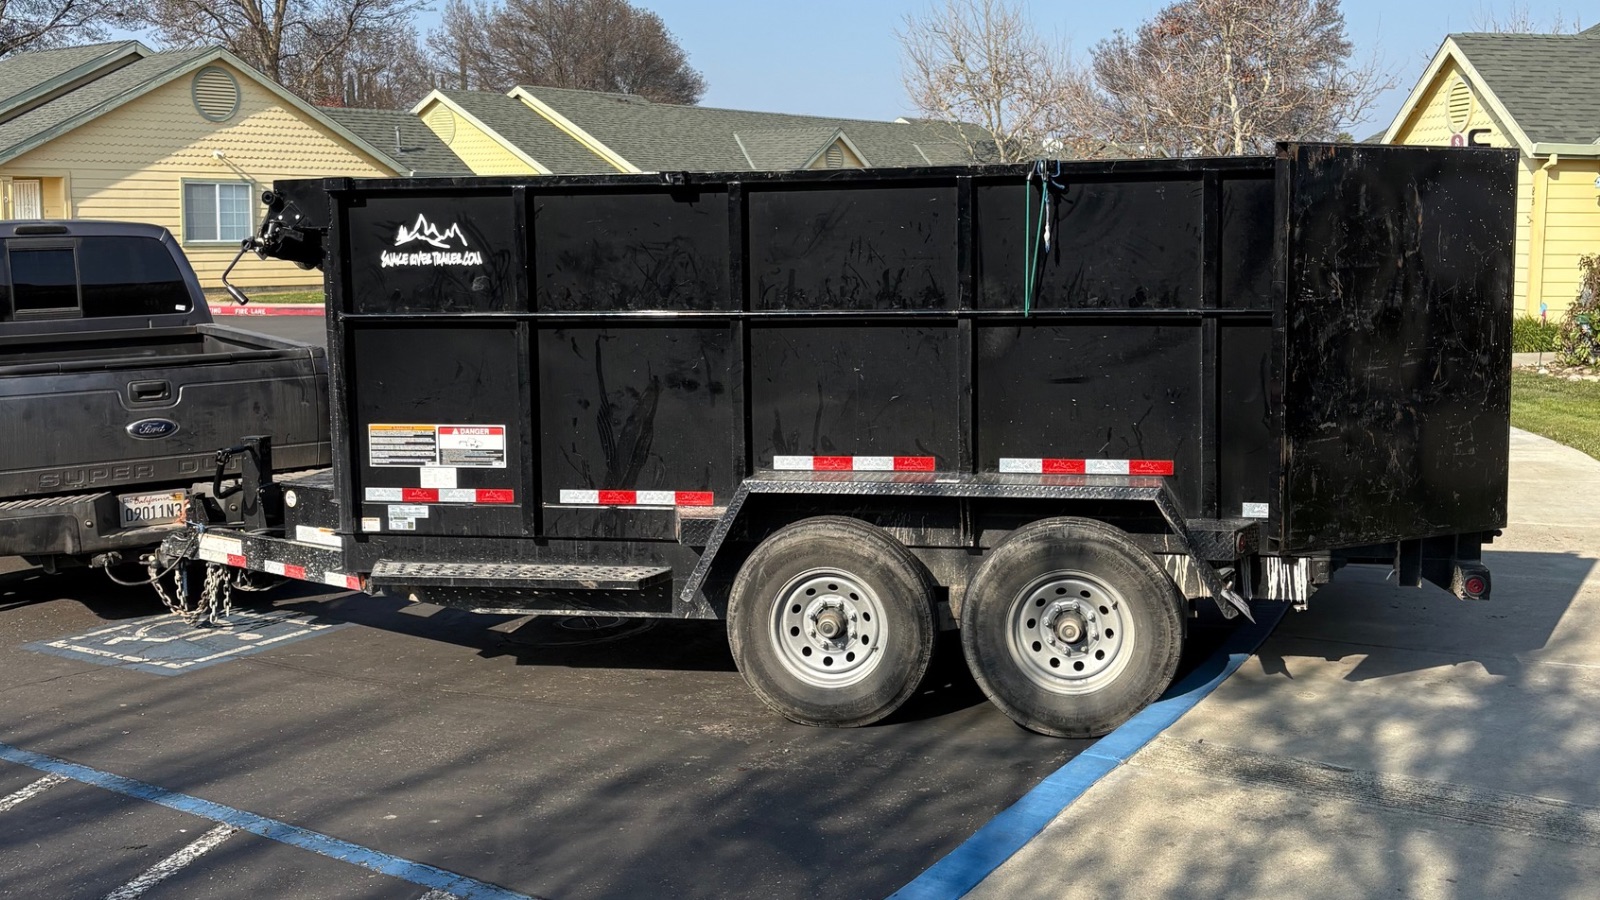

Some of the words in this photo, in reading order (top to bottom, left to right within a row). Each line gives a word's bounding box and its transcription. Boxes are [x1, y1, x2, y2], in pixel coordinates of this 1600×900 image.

[380, 250, 408, 268] SNAKE
[409, 250, 432, 267] RIVER
[459, 427, 490, 436] DANGER
[38, 464, 154, 488] SUPER
